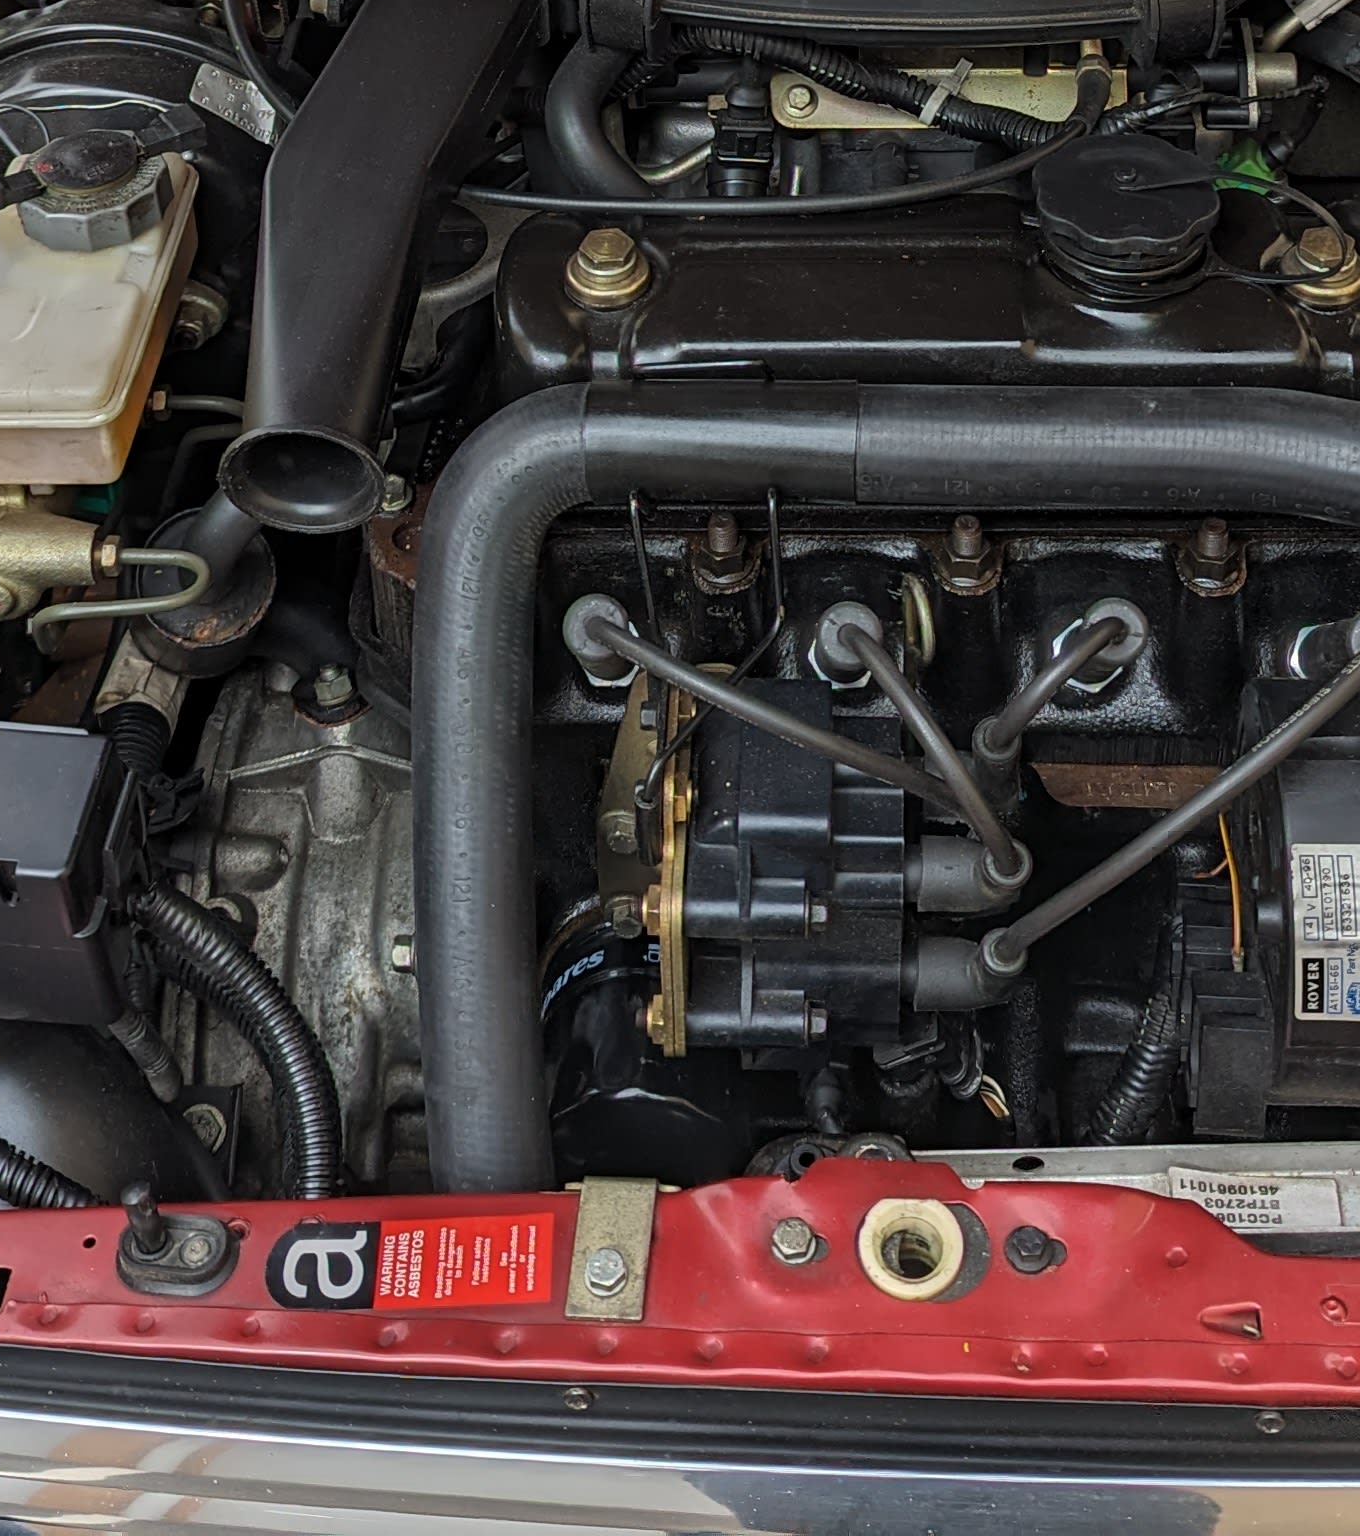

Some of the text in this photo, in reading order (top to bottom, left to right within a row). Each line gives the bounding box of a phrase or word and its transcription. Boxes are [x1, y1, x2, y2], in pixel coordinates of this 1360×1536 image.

[1307, 903, 1317, 912] V
[1305, 921, 1315, 937] 14
[540, 950, 605, 1020] pares
[1308, 961, 1321, 1010] ROVER
[1346, 958, 1357, 975] Part
[1216, 1212, 1283, 1225] PCC106
[434, 1227, 448, 1299] Breathing asbestos
[446, 1229, 457, 1269] dangerous
[454, 1245, 464, 1278] to health
[471, 1236, 484, 1286] Follow safety
[499, 1251, 508, 1267] See
[509, 1224, 519, 1262] handbook
[519, 1253, 526, 1263] or
[526, 1225, 537, 1292] workshop manual
[283, 1230, 368, 1299] a
[379, 1235, 397, 1296] WARNING
[393, 1232, 411, 1297] CONTAINS
[408, 1230, 425, 1298] ASBESTOS
[444, 1278, 453, 1296] dust
